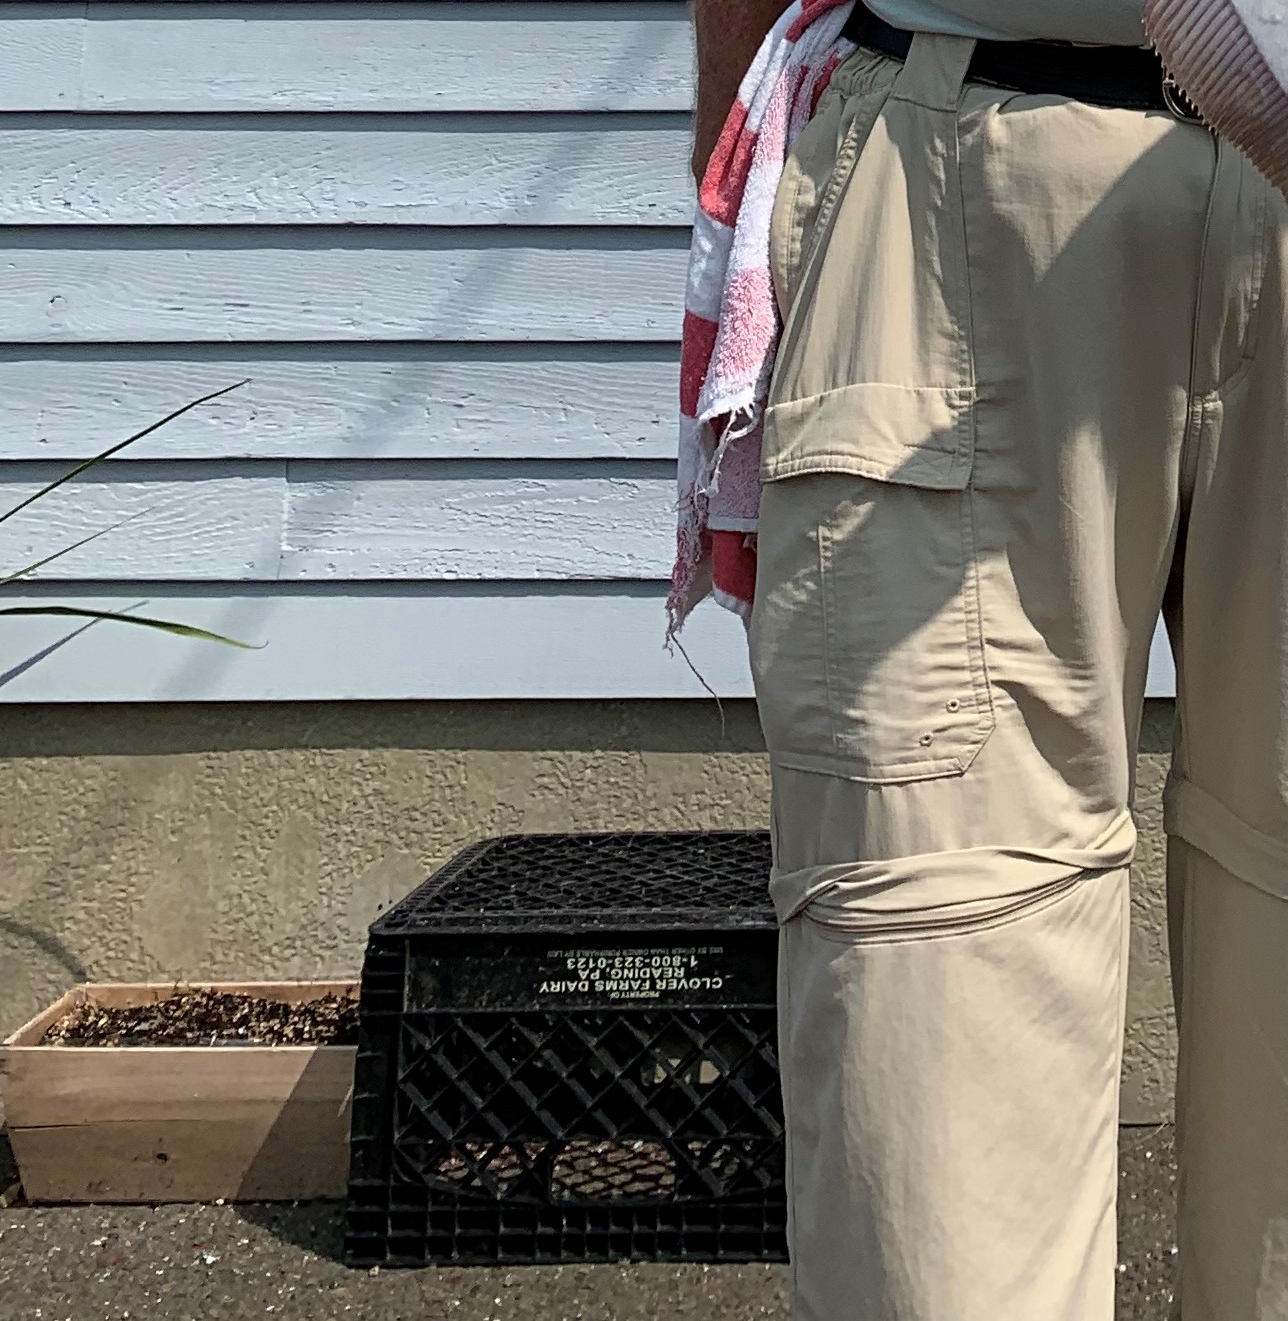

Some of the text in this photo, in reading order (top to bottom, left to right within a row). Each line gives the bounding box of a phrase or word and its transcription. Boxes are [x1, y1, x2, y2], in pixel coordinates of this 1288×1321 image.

[566, 955, 698, 970] 1-800-323-0123
[578, 967, 685, 980] READING, PA
[538, 977, 723, 994] CLOVER FARMS DAIRY
[621, 991, 660, 999] PROPERTY
